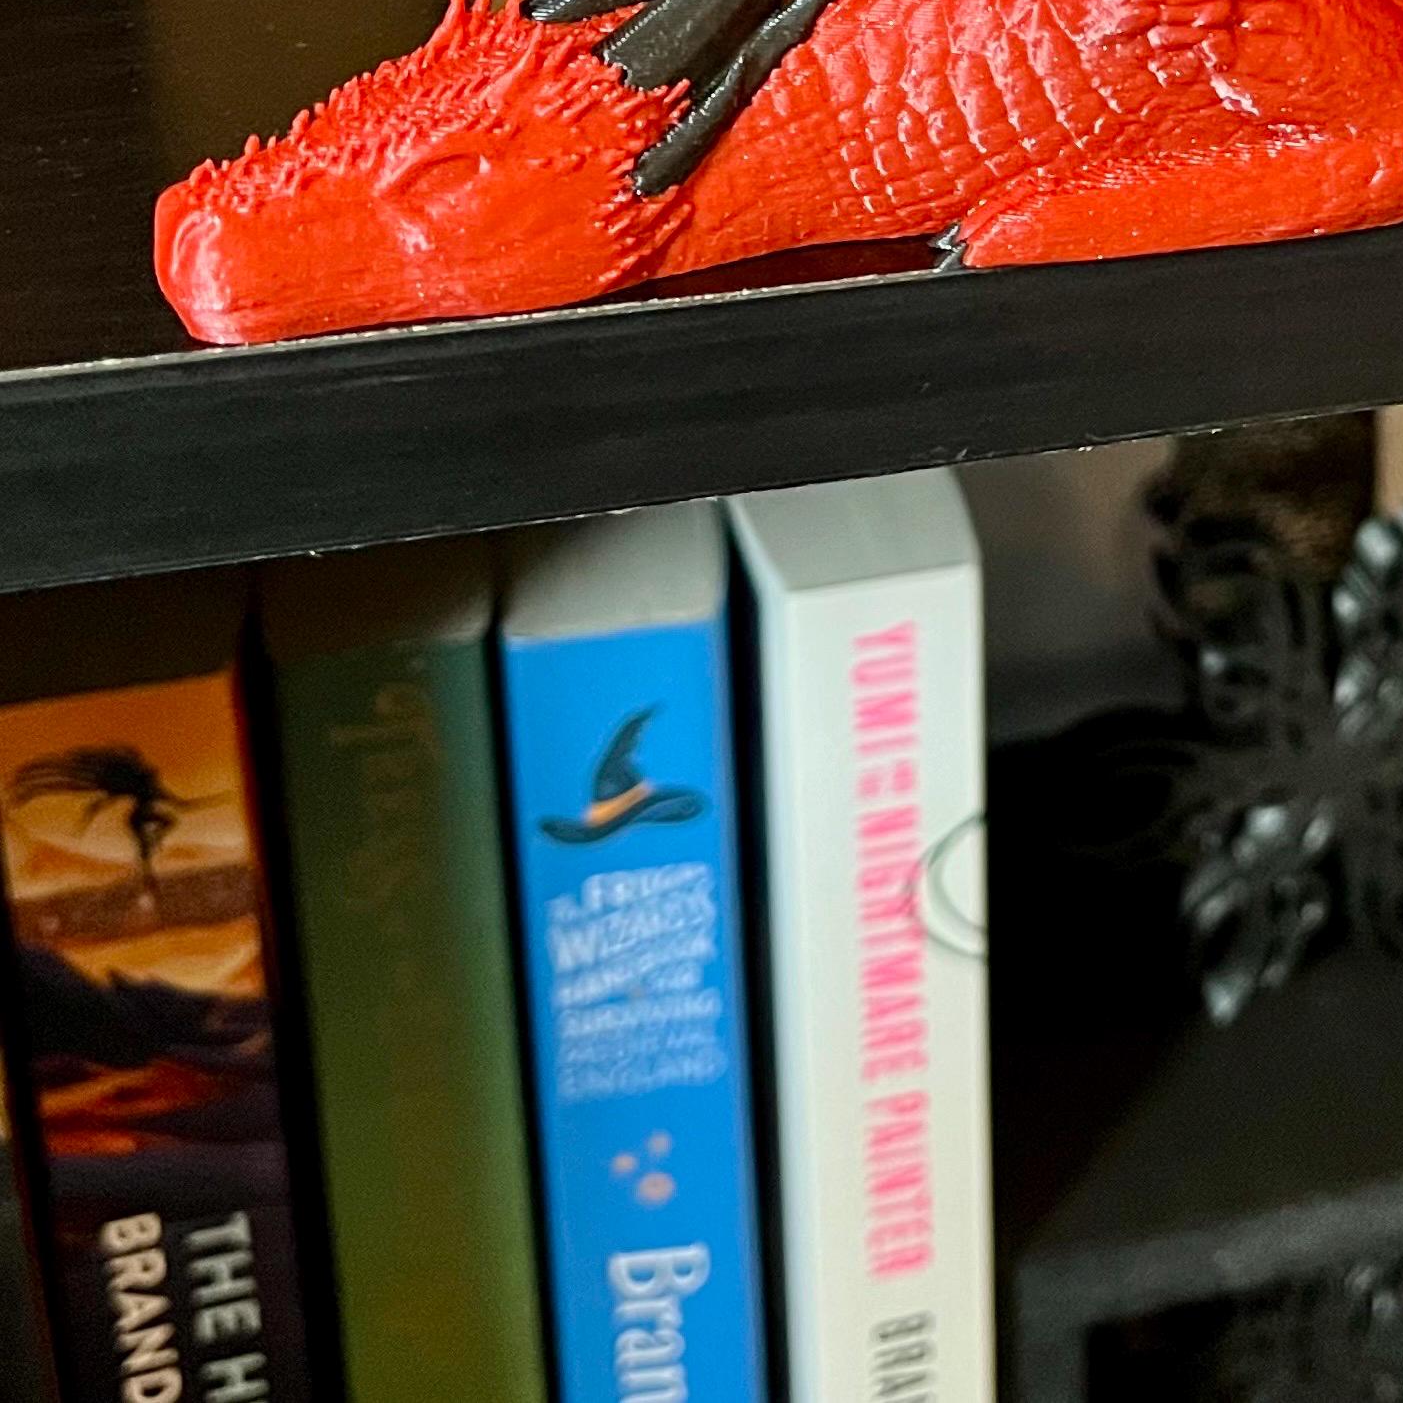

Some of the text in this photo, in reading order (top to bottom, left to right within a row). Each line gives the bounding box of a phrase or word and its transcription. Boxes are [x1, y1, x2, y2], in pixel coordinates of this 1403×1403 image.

[850, 618, 919, 757] YUMI
[856, 804, 930, 1085] NIGHTMARE
[861, 1089, 936, 1281] PAINTER
[184, 1210, 263, 1344] THE
